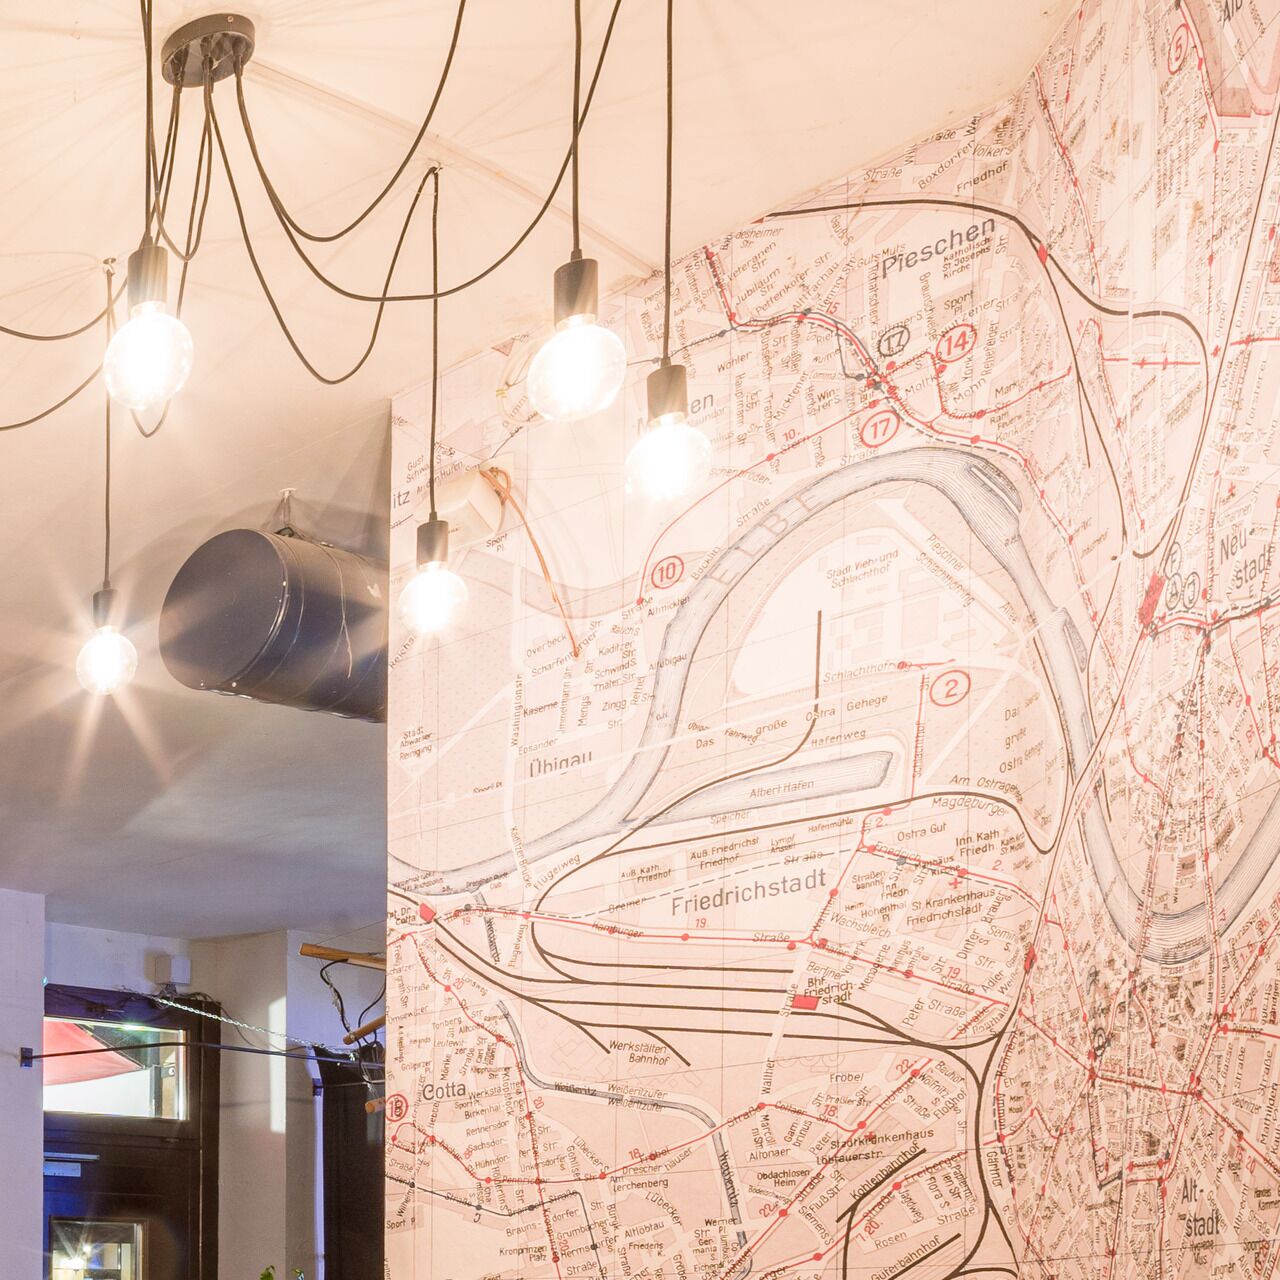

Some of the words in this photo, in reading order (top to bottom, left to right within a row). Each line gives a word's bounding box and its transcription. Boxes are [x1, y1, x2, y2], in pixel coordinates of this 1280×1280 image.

[956, 162, 1009, 193] Friedhof
[882, 219, 996, 279] Pieschen
[944, 291, 974, 310] Sport
[945, 332, 969, 356] 14
[598, 641, 634, 656] Kaditzer
[523, 701, 559, 717] Kaserne
[602, 700, 627, 712] Zingg
[847, 695, 888, 712] Gehege
[805, 707, 837, 721] Ostra
[756, 719, 787, 734] große
[695, 736, 714, 748] Das
[811, 729, 867, 747] Hafenweg
[950, 775, 969, 784] Am
[750, 785, 780, 798] Albert
[781, 779, 814, 797] Hafen
[897, 828, 924, 841] Ostra
[925, 822, 947, 836] Gut
[699, 854, 740, 869] Friedhof
[637, 870, 672, 882] Friedhof
[671, 867, 827, 916] Friedrichstadt
[926, 889, 995, 908] Krankenhaus
[695, 918, 707, 928] 19
[906, 904, 983, 925] Friedrichstadt
[753, 933, 790, 942] Straße
[947, 966, 961, 978] 19
[823, 991, 852, 1004] stadt
[903, 998, 924, 1027] Peter
[928, 999, 966, 1018] Straße
[628, 1053, 670, 1065] Bahnhof
[422, 1082, 466, 1100] Cotta
[757, 1169, 810, 1179] Obdachlosen
[850, 1142, 921, 1201] Kohlenbahnhof
[774, 1178, 796, 1187] Heim
[937, 1207, 975, 1225] Straße
[1186, 1211, 1221, 1236] stadt
[874, 1232, 907, 1249] Rosen
